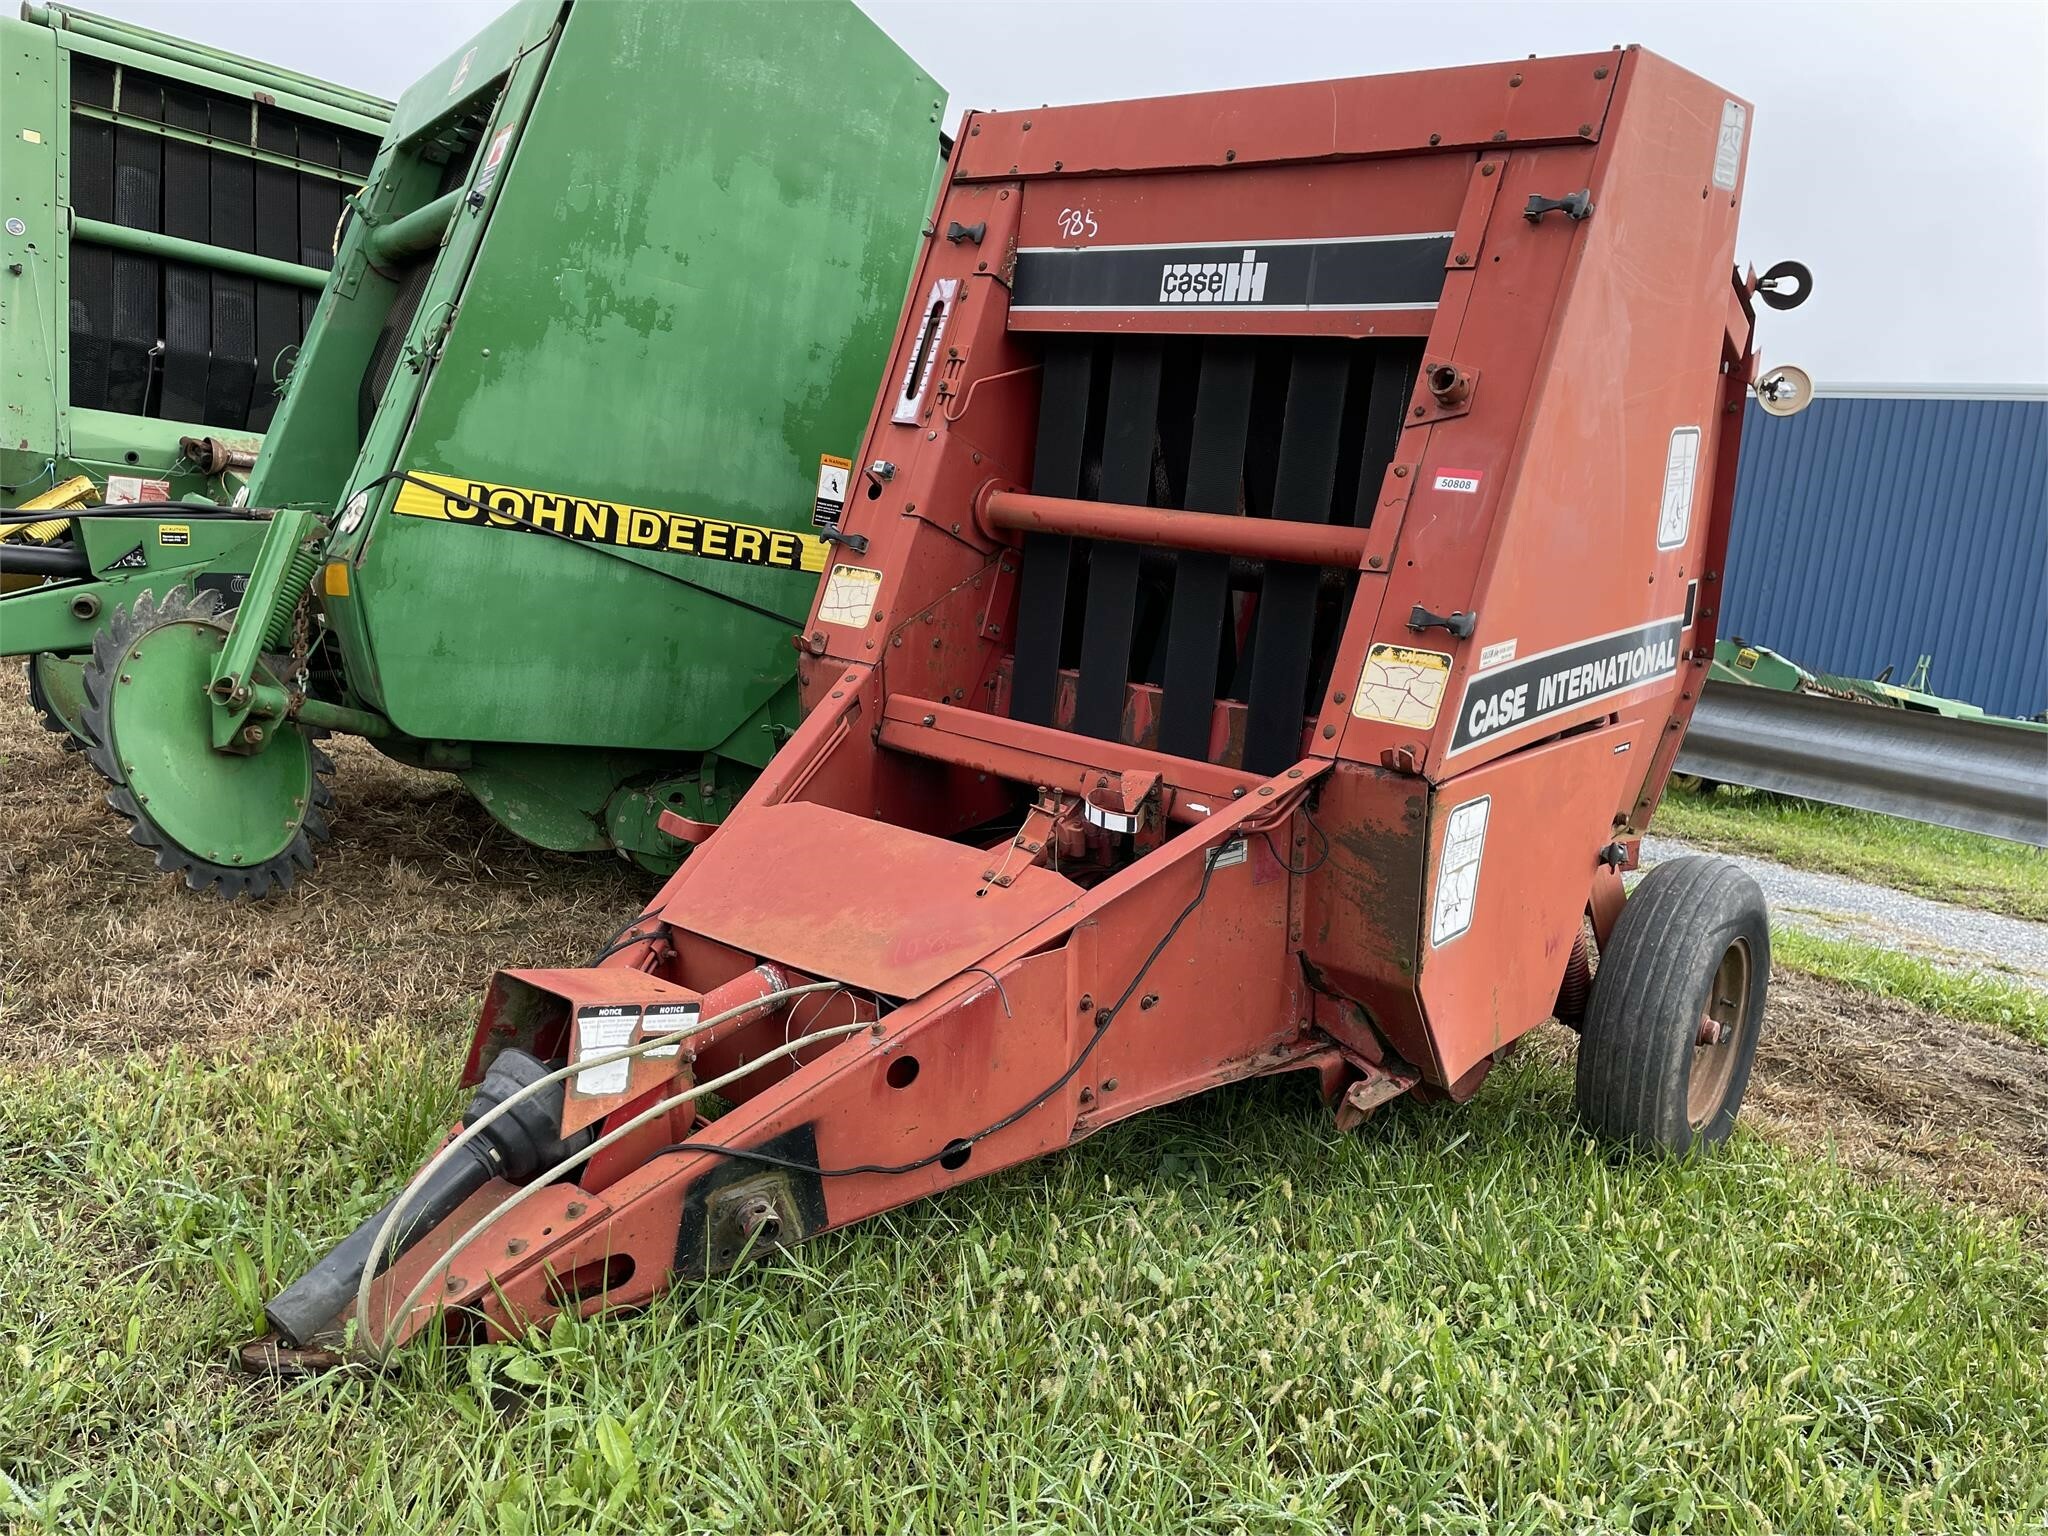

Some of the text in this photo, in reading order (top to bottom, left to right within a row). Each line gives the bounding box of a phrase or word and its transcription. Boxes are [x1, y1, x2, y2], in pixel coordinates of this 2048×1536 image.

[1441, 478, 1472, 490] 50808
[446, 484, 611, 540] JOHN
[629, 511, 796, 566] DEERE
[1468, 638, 1676, 737] CASE INTERNATIONAL
[598, 1008, 622, 1016] NOTICE
[660, 1005, 685, 1014] NOTICE
